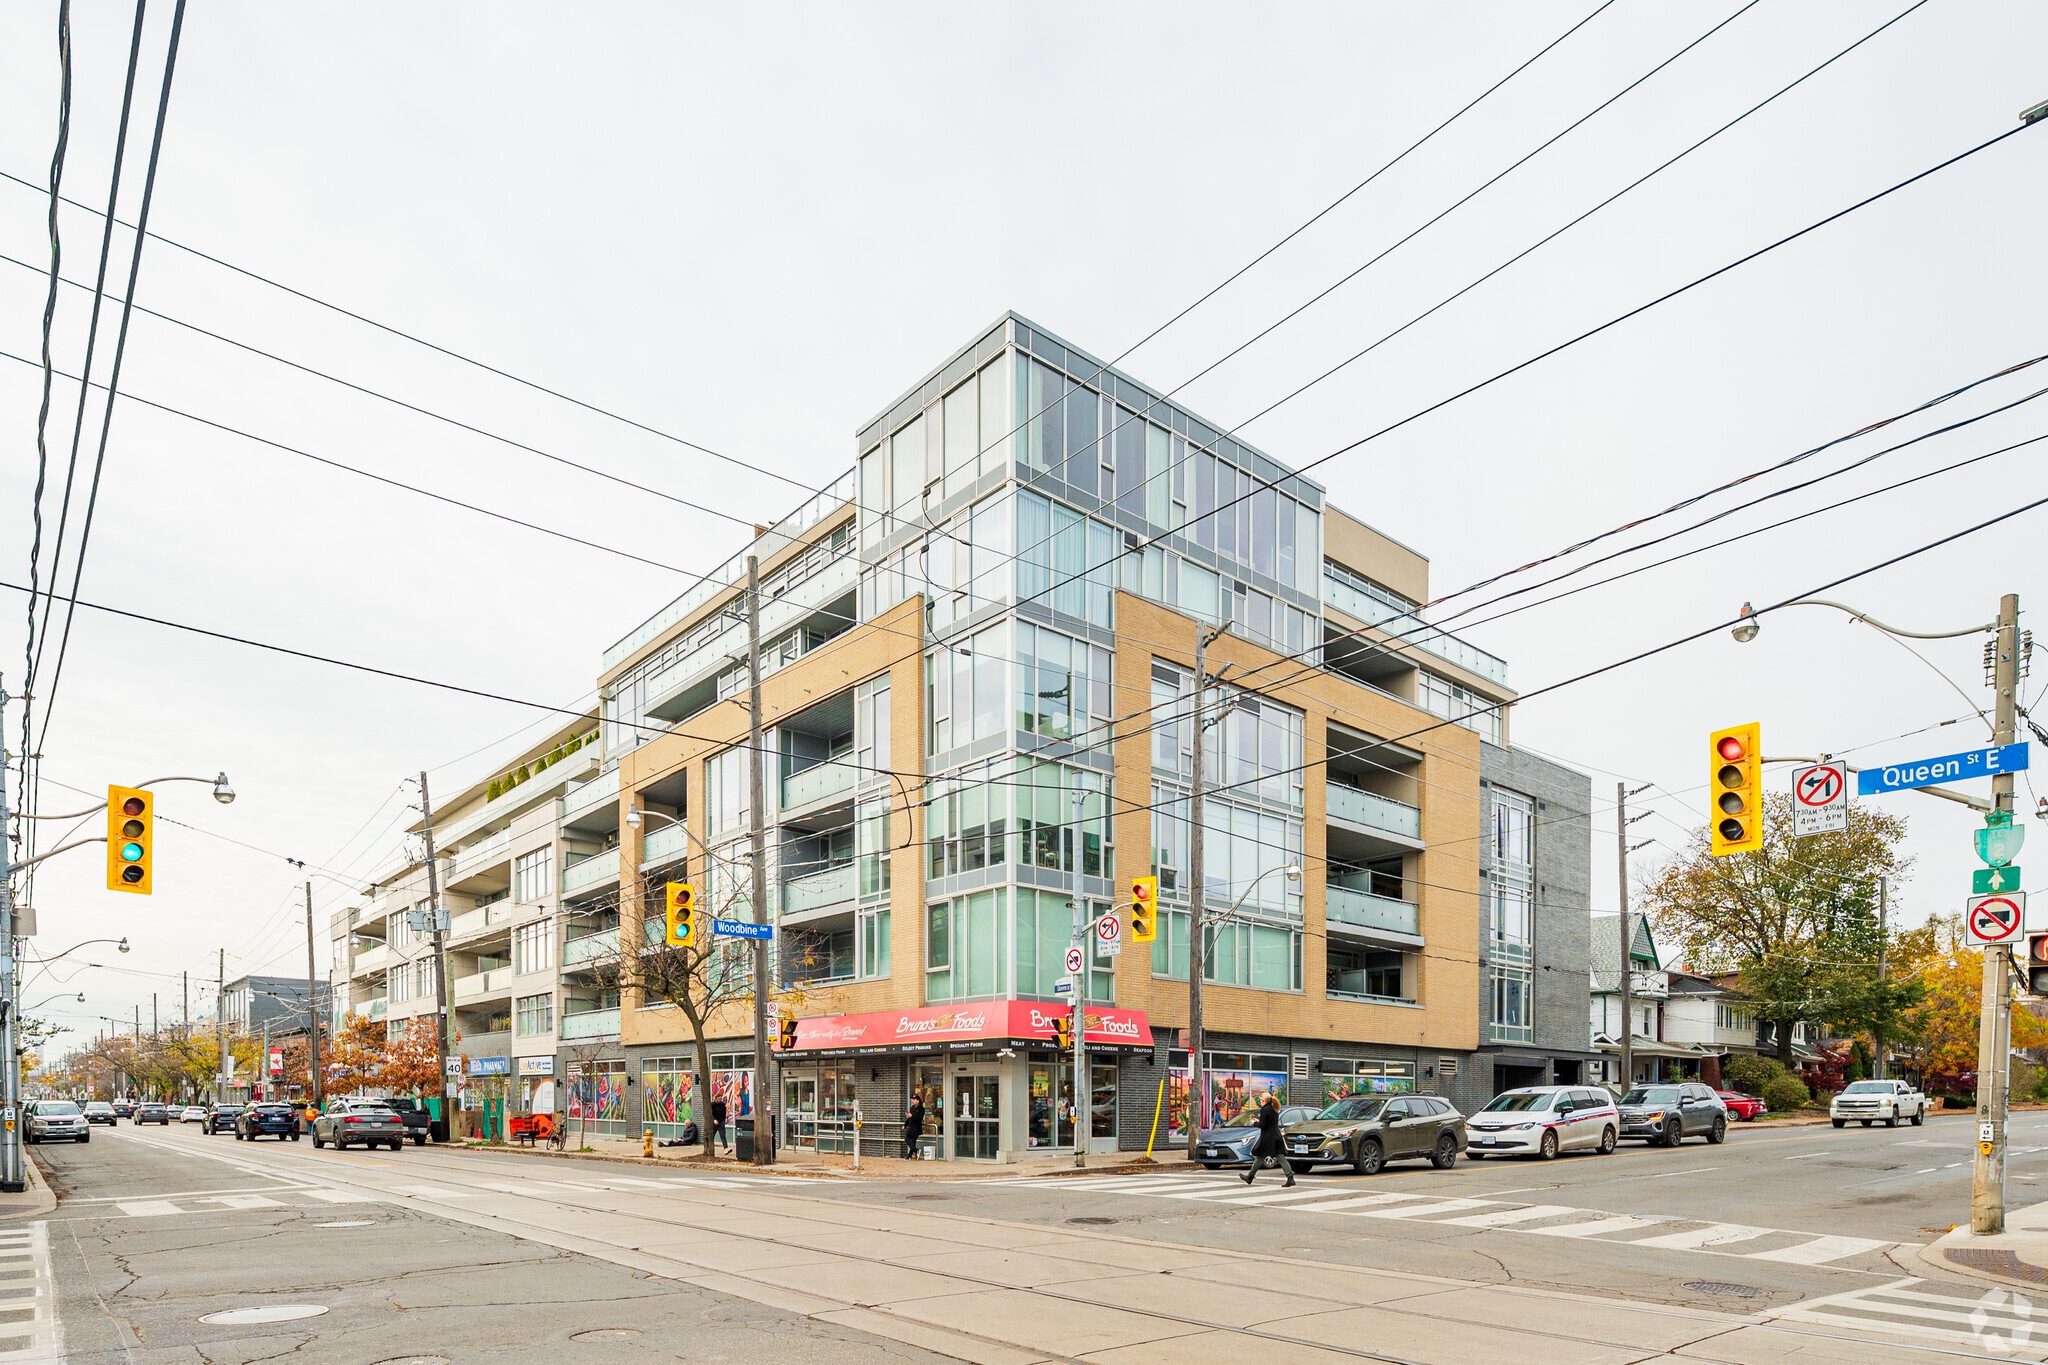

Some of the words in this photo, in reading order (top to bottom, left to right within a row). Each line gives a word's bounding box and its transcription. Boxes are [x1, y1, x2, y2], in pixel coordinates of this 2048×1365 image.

[1882, 759, 1960, 787] Queen
[1967, 752, 1980, 766] St
[1986, 749, 2000, 770] E
[1994, 843, 2005, 857] 2
[718, 922, 758, 935] Woodbine
[896, 1016, 936, 1032] Bruno's
[952, 1010, 986, 1029] Foods
[1101, 1016, 1138, 1034] Foods
[448, 1064, 460, 1072] 40
